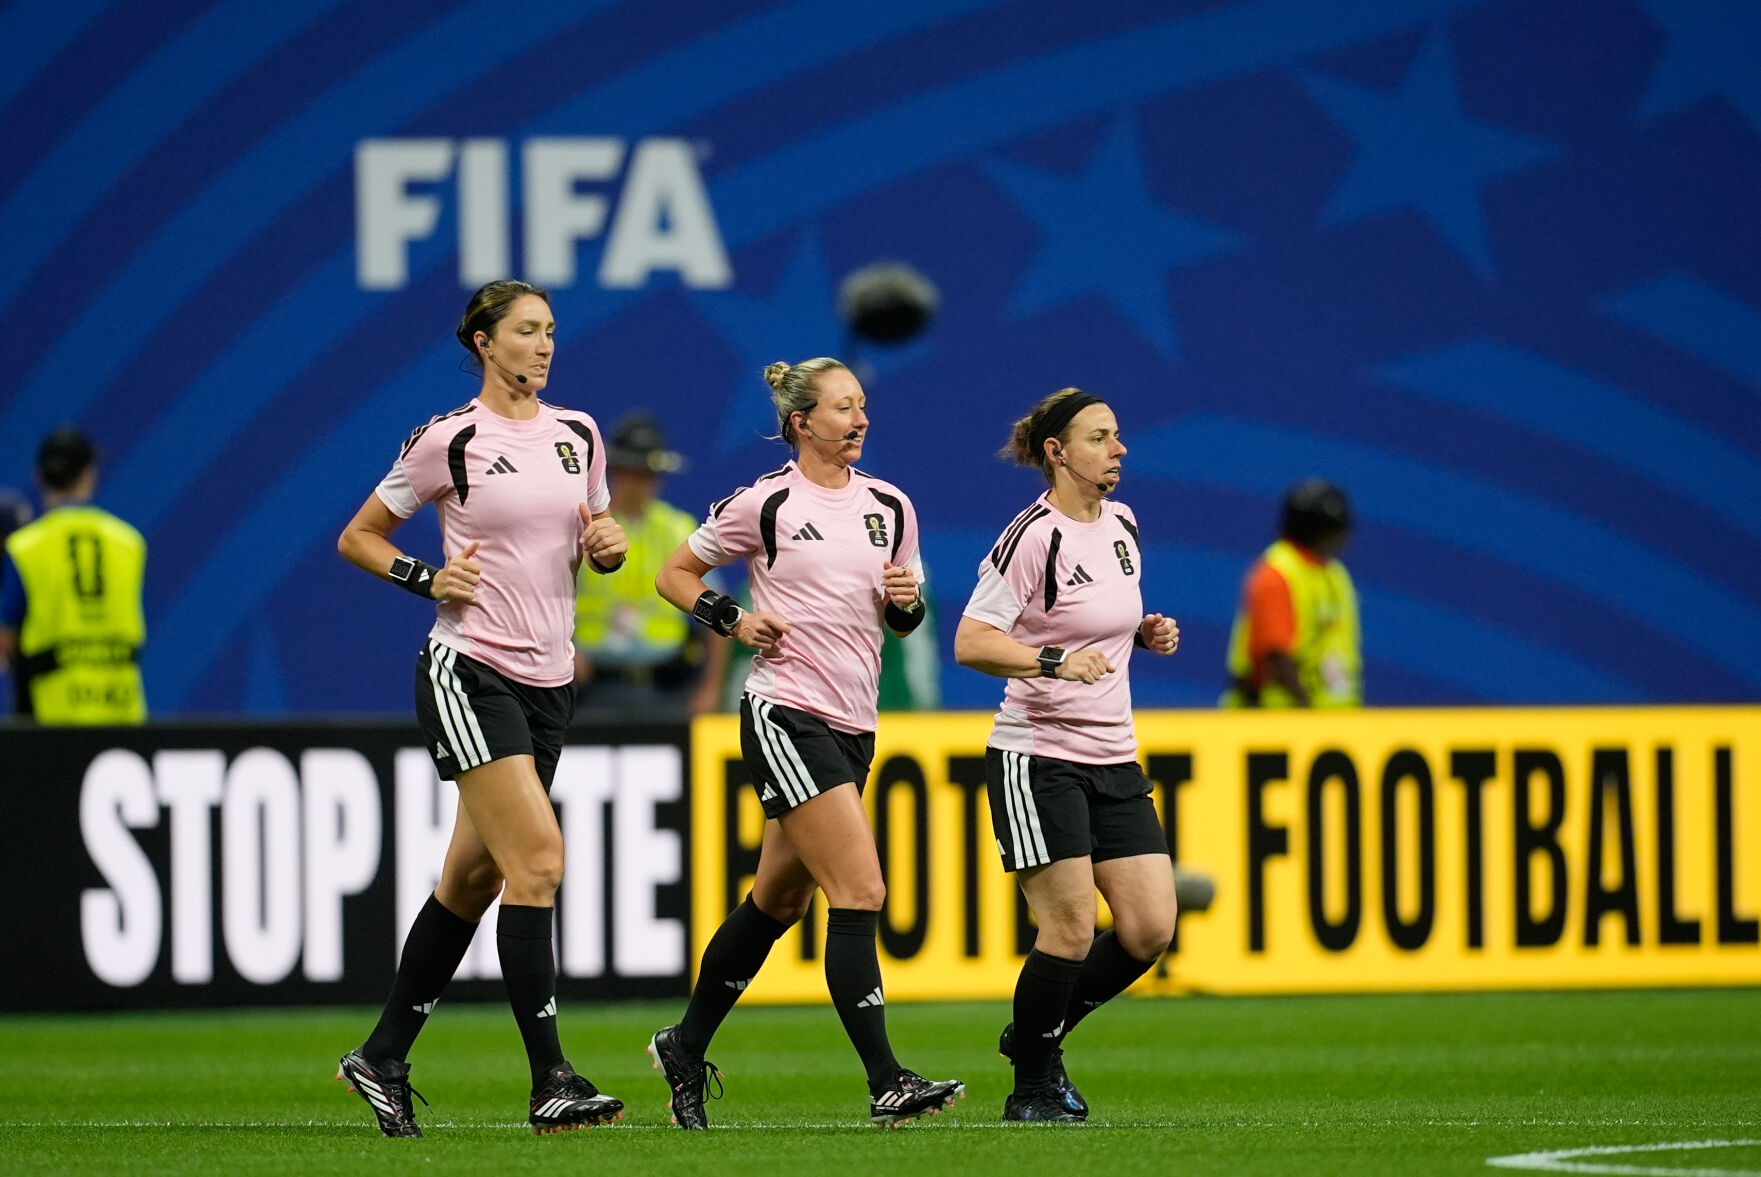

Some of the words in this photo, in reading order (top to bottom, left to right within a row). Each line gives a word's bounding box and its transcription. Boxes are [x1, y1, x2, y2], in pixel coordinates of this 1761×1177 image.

[354, 137, 733, 291] FIFA
[79, 746, 382, 988] STOP
[395, 745, 685, 981] HTE
[1246, 746, 1760, 953] FOOTBALL
